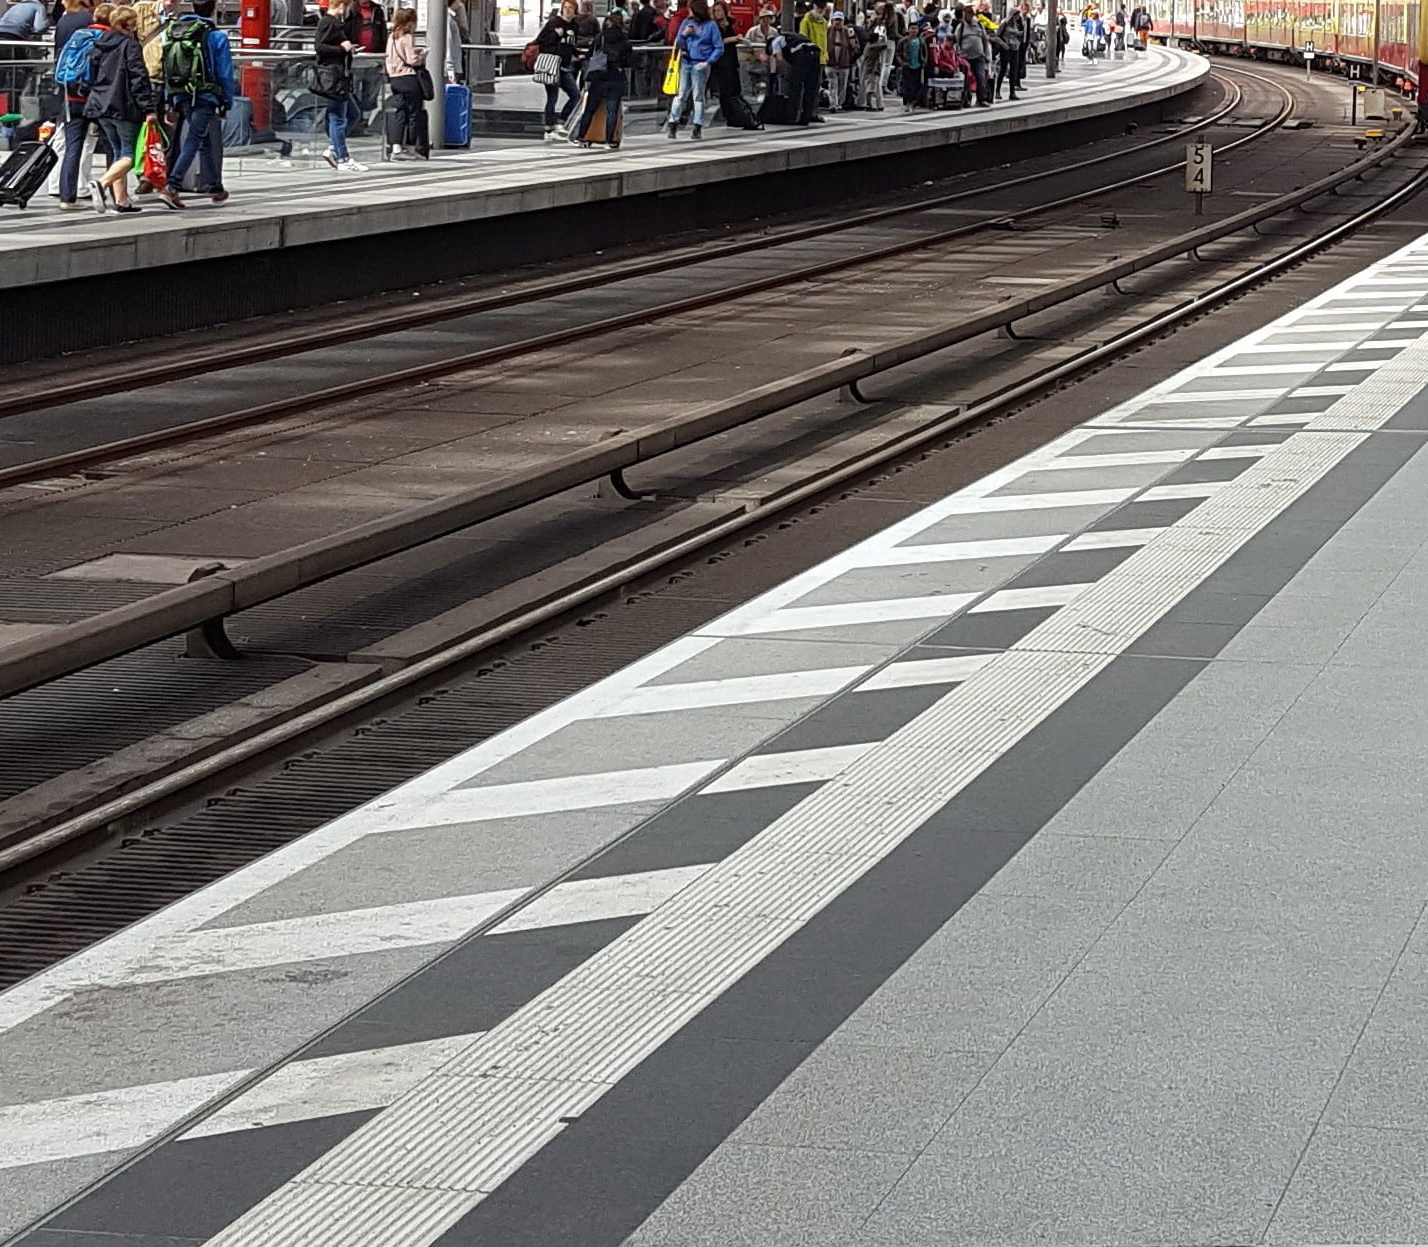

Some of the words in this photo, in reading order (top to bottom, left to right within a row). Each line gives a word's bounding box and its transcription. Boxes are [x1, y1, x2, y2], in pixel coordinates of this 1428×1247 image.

[1306, 42, 1313, 52] H
[1350, 65, 1360, 79] H
[1193, 147, 1204, 164] 5
[1193, 167, 1204, 184] 4
